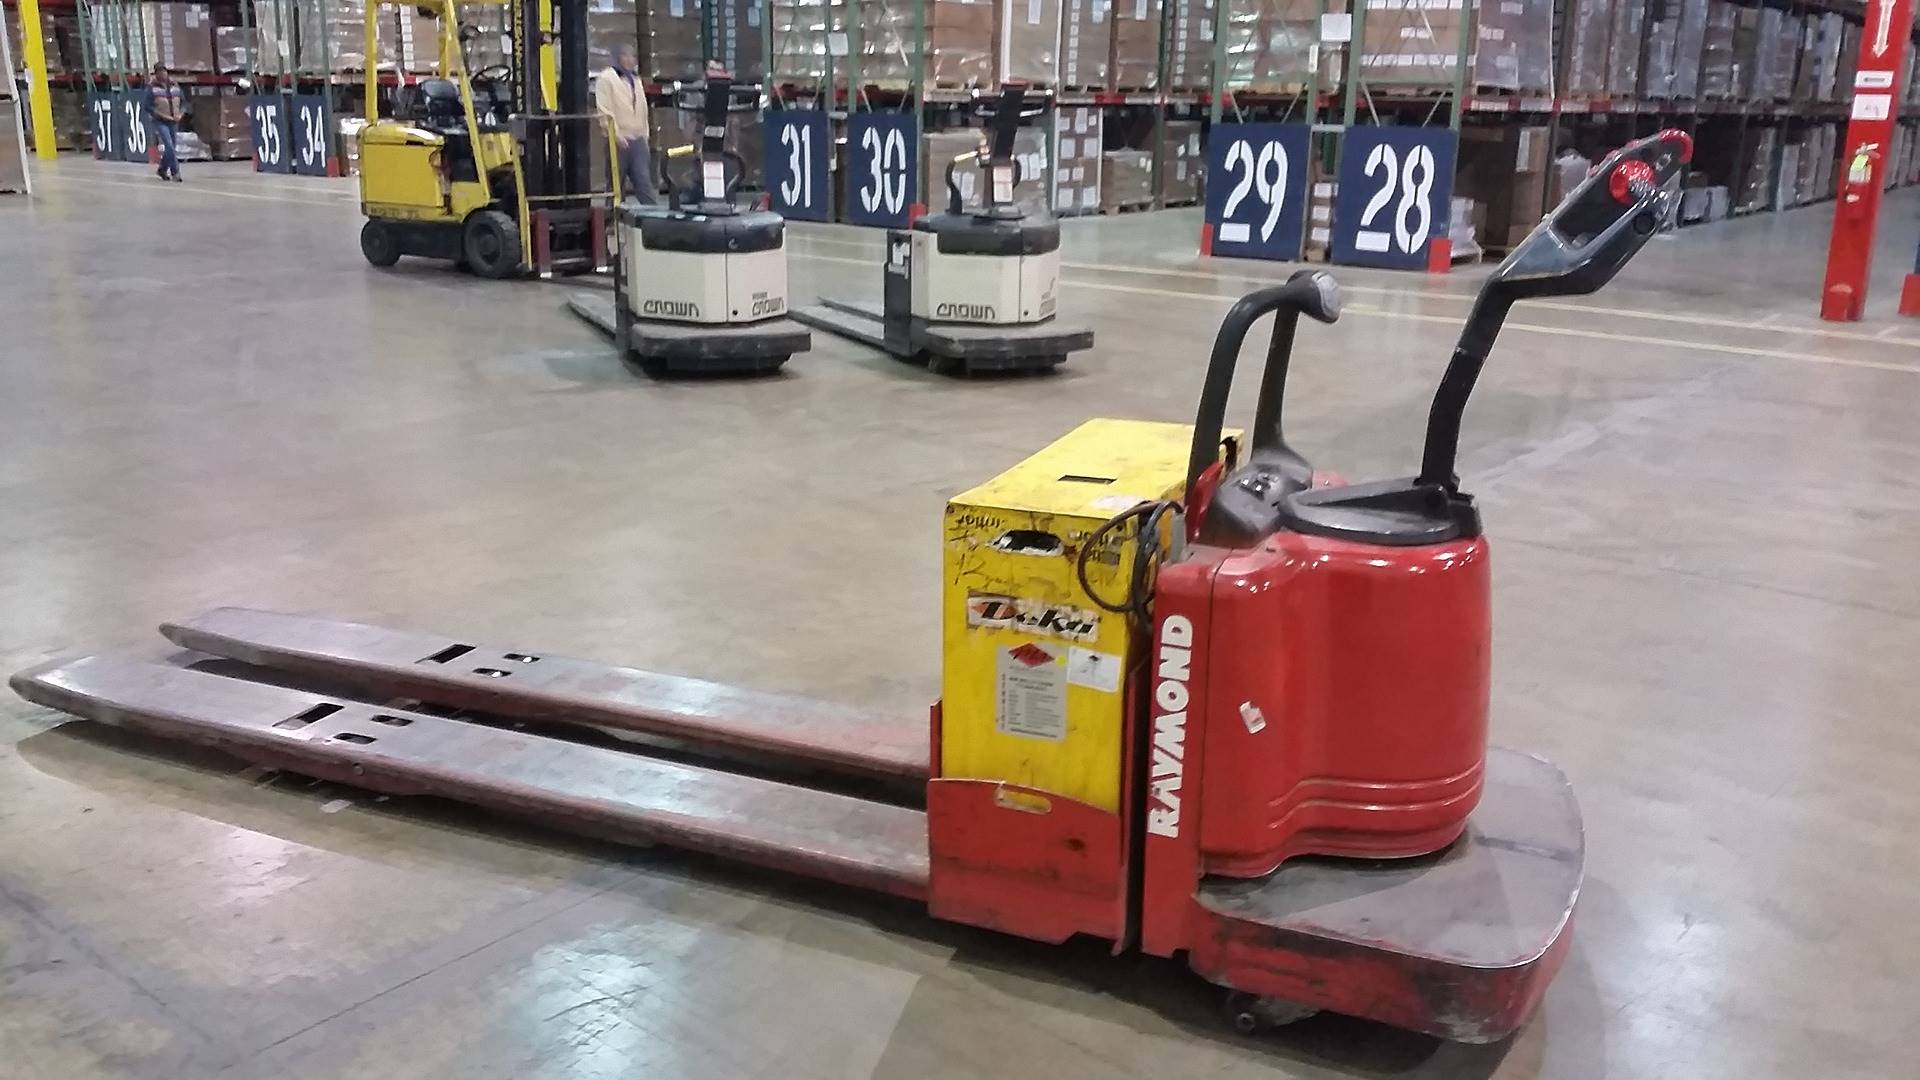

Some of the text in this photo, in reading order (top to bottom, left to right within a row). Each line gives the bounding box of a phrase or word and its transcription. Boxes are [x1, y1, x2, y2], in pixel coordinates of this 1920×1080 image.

[95, 100, 112, 152] 37
[125, 100, 146, 153] 36
[256, 105, 280, 165] 35
[301, 105, 326, 168] 34
[781, 123, 811, 208] 31
[860, 126, 906, 214] 30
[1219, 139, 1288, 243] 29
[1355, 143, 1435, 254] 28
[1147, 614, 1193, 839] RAYMOND
